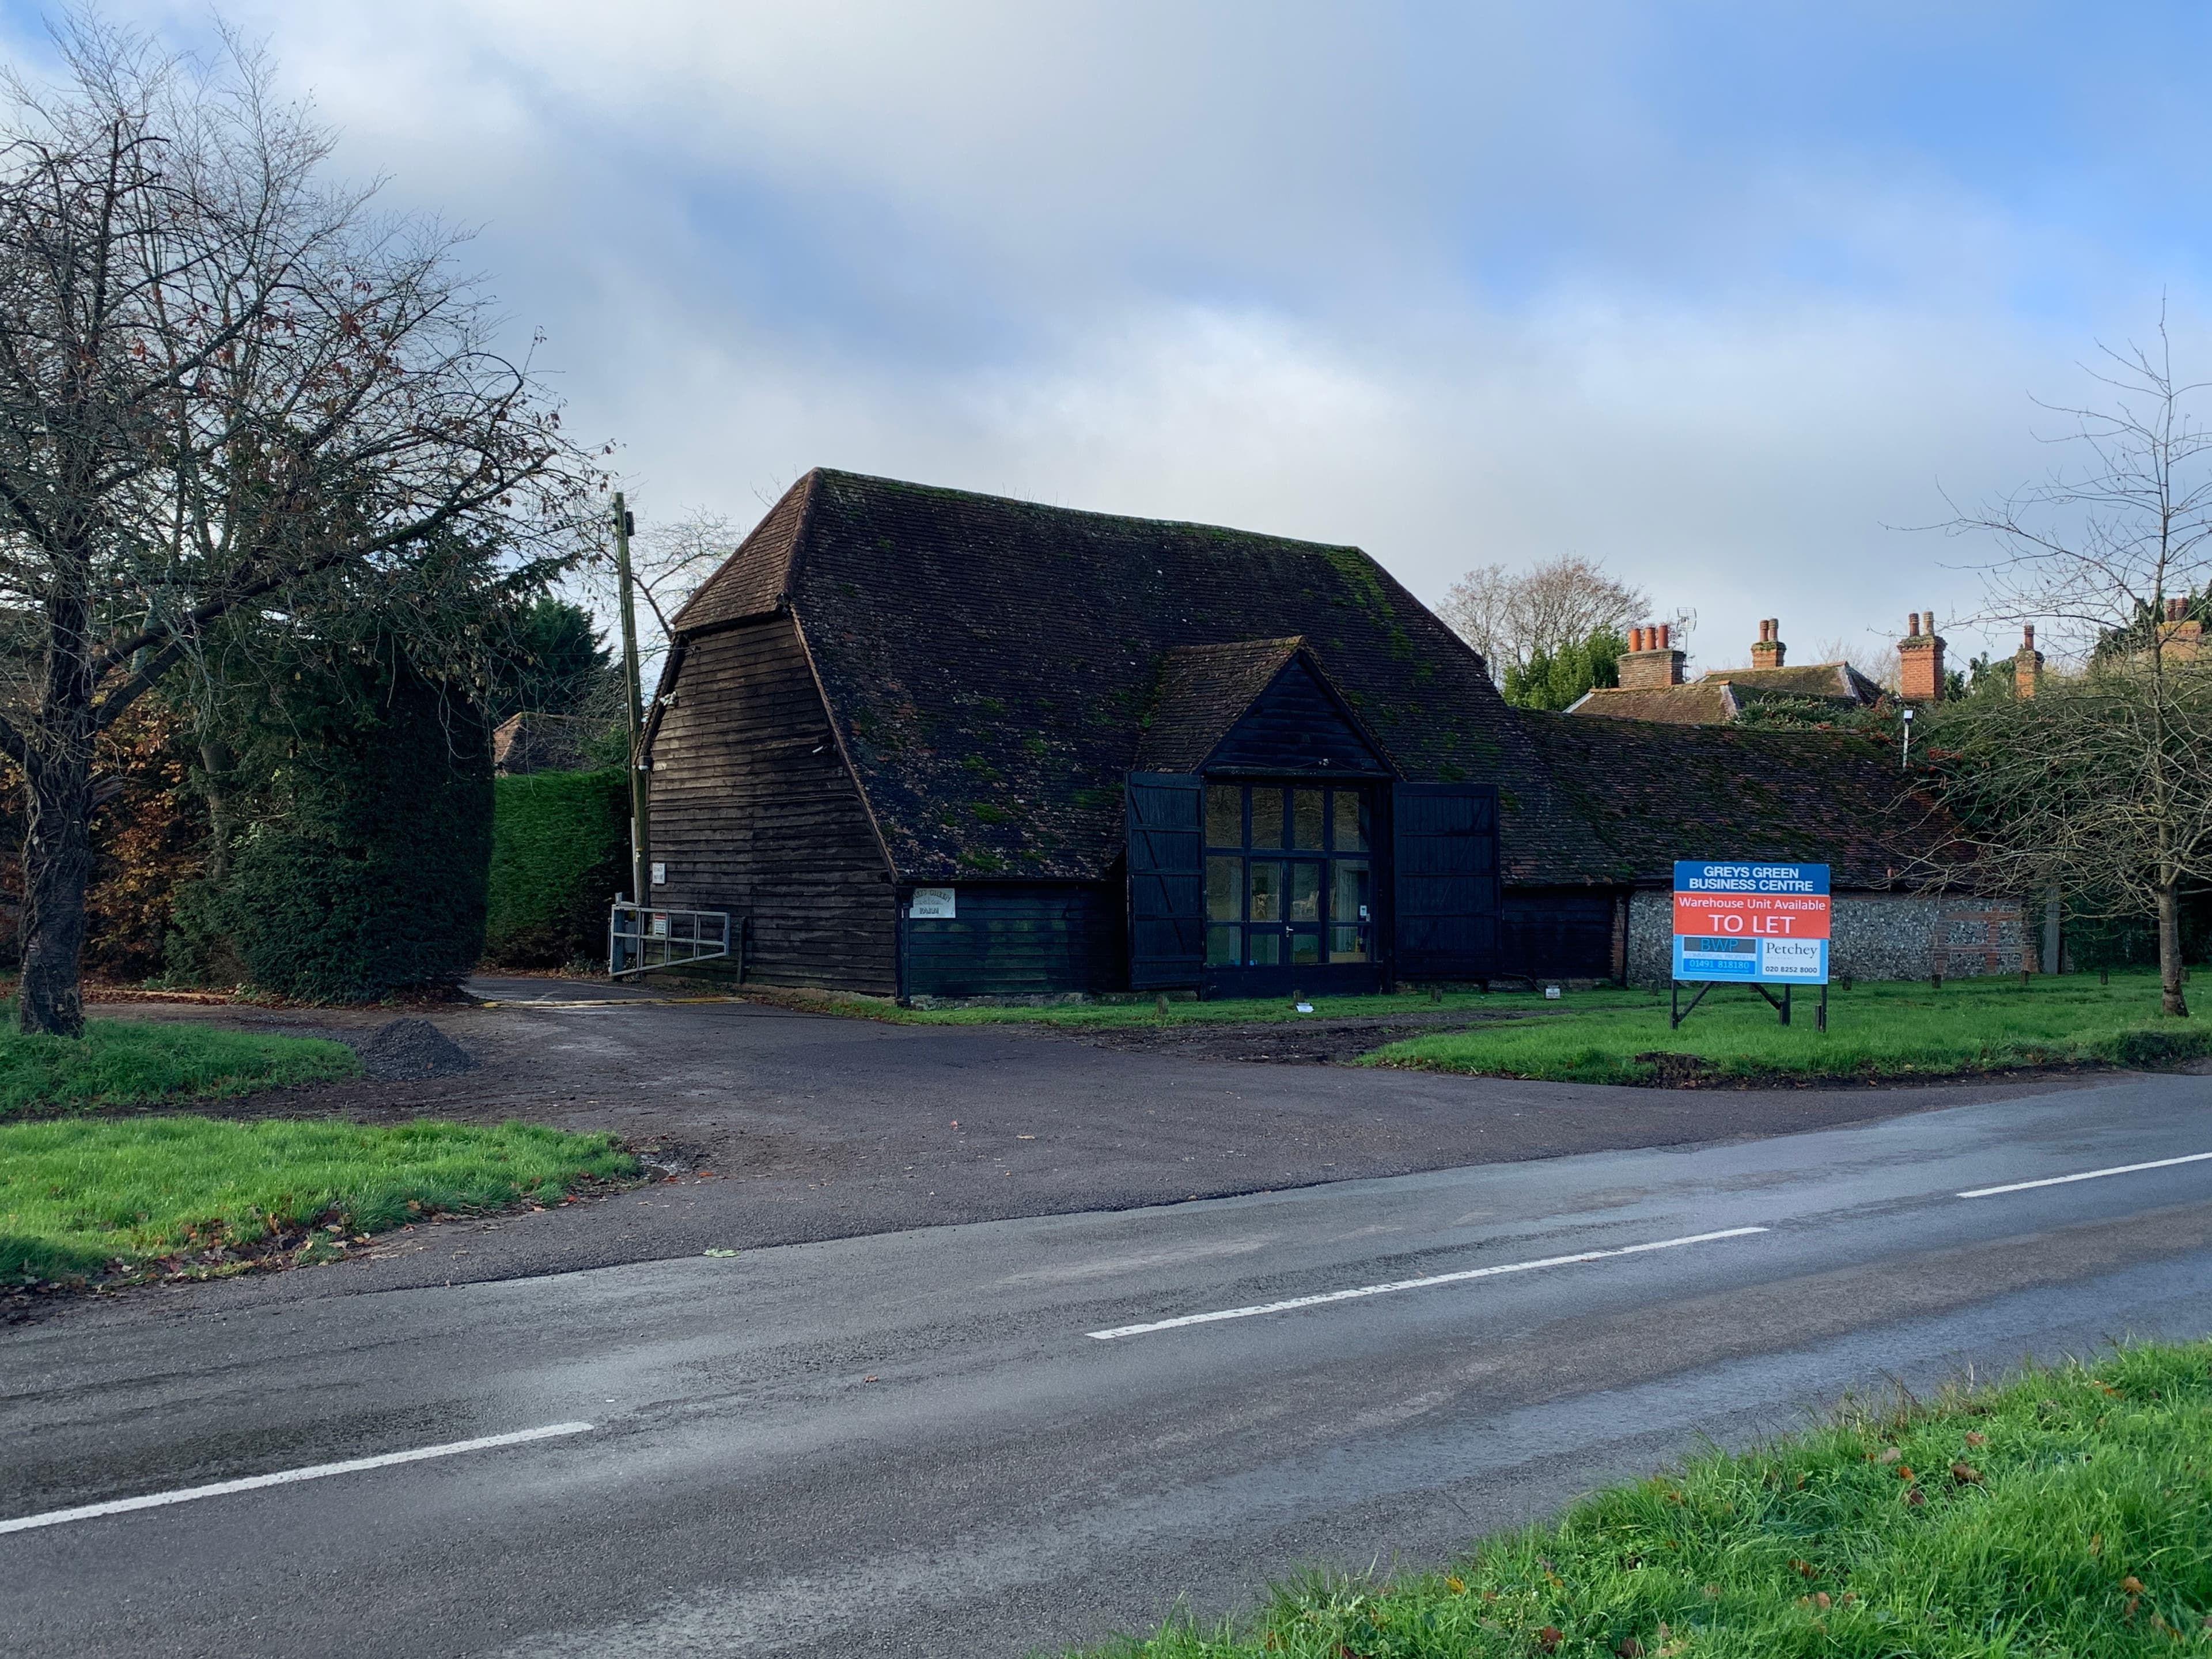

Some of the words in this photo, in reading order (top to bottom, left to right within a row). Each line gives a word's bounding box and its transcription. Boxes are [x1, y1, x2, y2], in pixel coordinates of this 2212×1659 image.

[1703, 866, 1749, 877] GREYS
[1752, 867, 1798, 878] GREEN
[1689, 878, 1756, 890] BUSINESS
[1759, 880, 1813, 891] CENTRE
[1679, 897, 1744, 908] Warehouse
[1747, 899, 1771, 909] Unit
[1774, 899, 1825, 910] Available
[1708, 914, 1743, 932] TO
[1753, 915, 1796, 933] LET
[1701, 938, 1738, 952] BWP
[1766, 942, 1817, 959] Petchey
[1689, 960, 1714, 968] 01491
[1717, 961, 1749, 969] 818180
